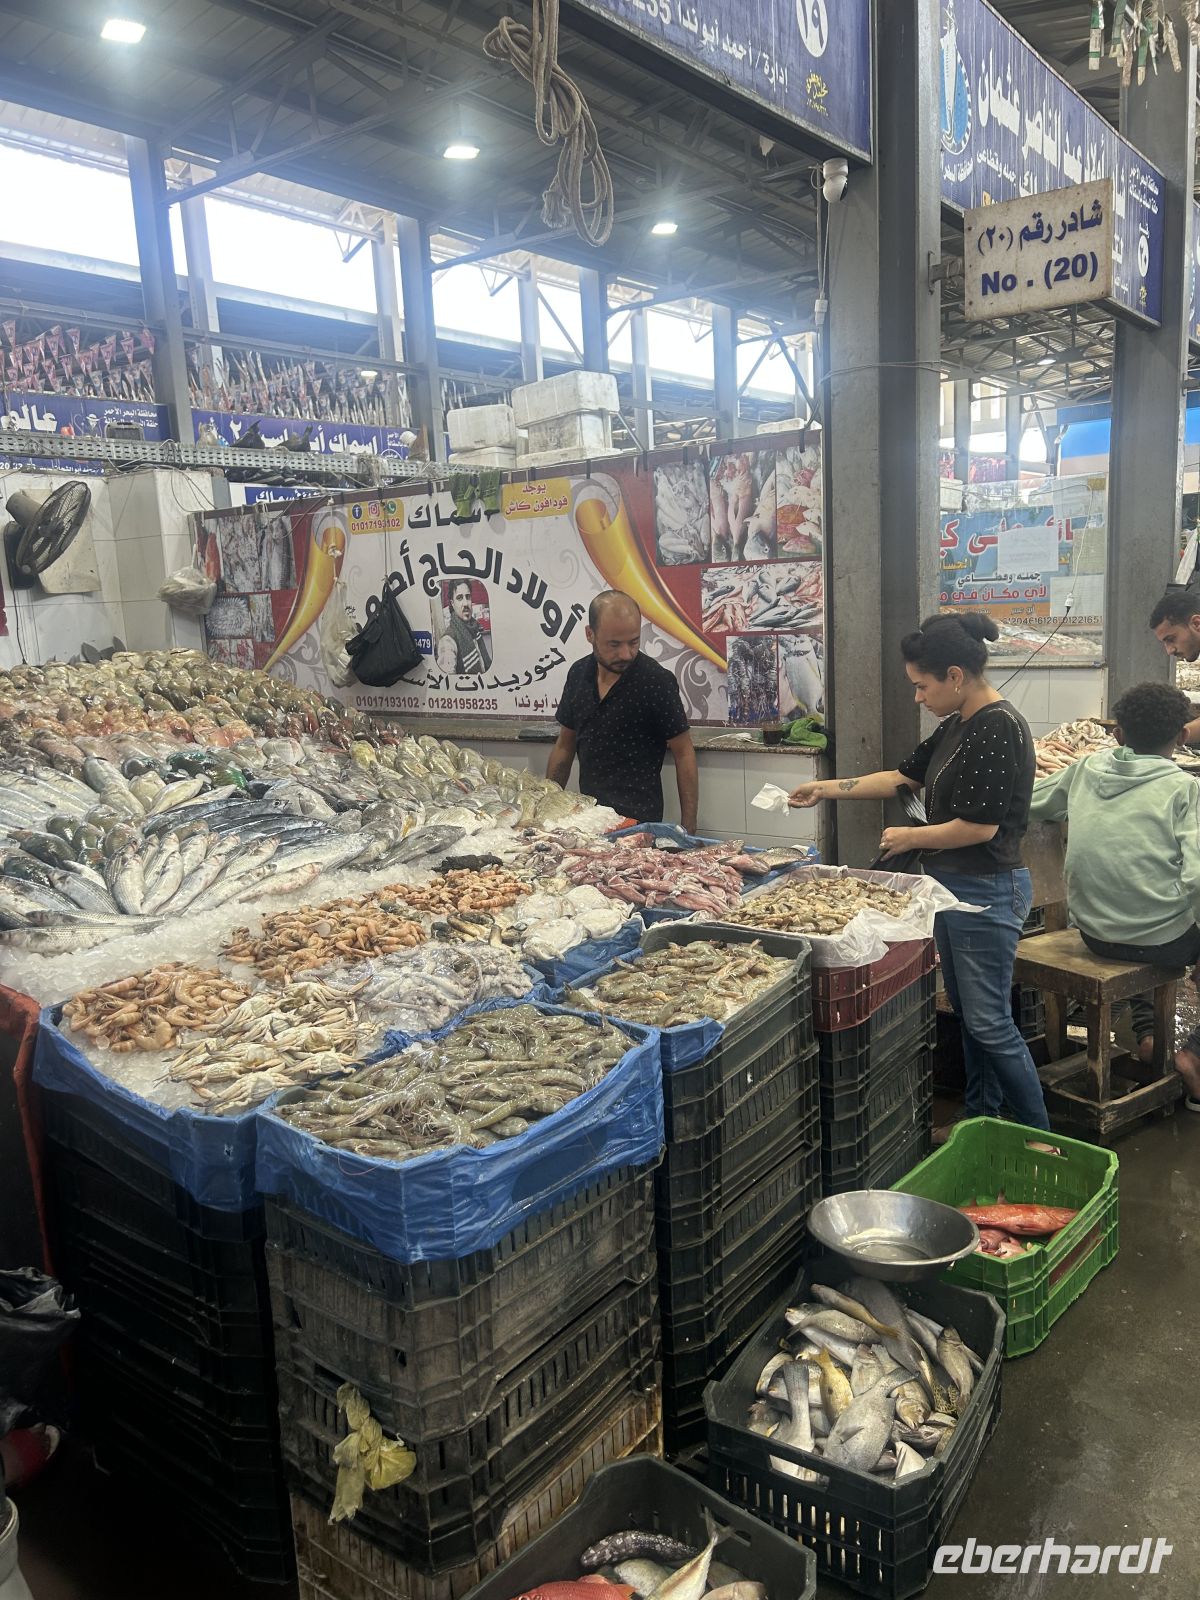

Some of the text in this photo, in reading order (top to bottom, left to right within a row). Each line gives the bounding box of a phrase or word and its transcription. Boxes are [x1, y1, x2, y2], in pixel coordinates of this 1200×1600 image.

[722, 33, 752, 66] أحمد
[1019, 212, 1053, 250] رقم
[1056, 199, 1103, 241] شادر
[977, 225, 1014, 256] (٢٠)
[982, 271, 1018, 296] No
[1044, 251, 1098, 290] (20)
[522, 483, 547, 494] يوجد
[505, 496, 568, 515] فودافون كاش
[418, 542, 504, 598] الحاج
[507, 567, 587, 645] أولاد
[952, 590, 978, 603] في
[981, 587, 1020, 602] مكان
[1023, 583, 1047, 601] لأي
[356, 696, 420, 709] 01017193102
[428, 697, 499, 711] 01281958235
